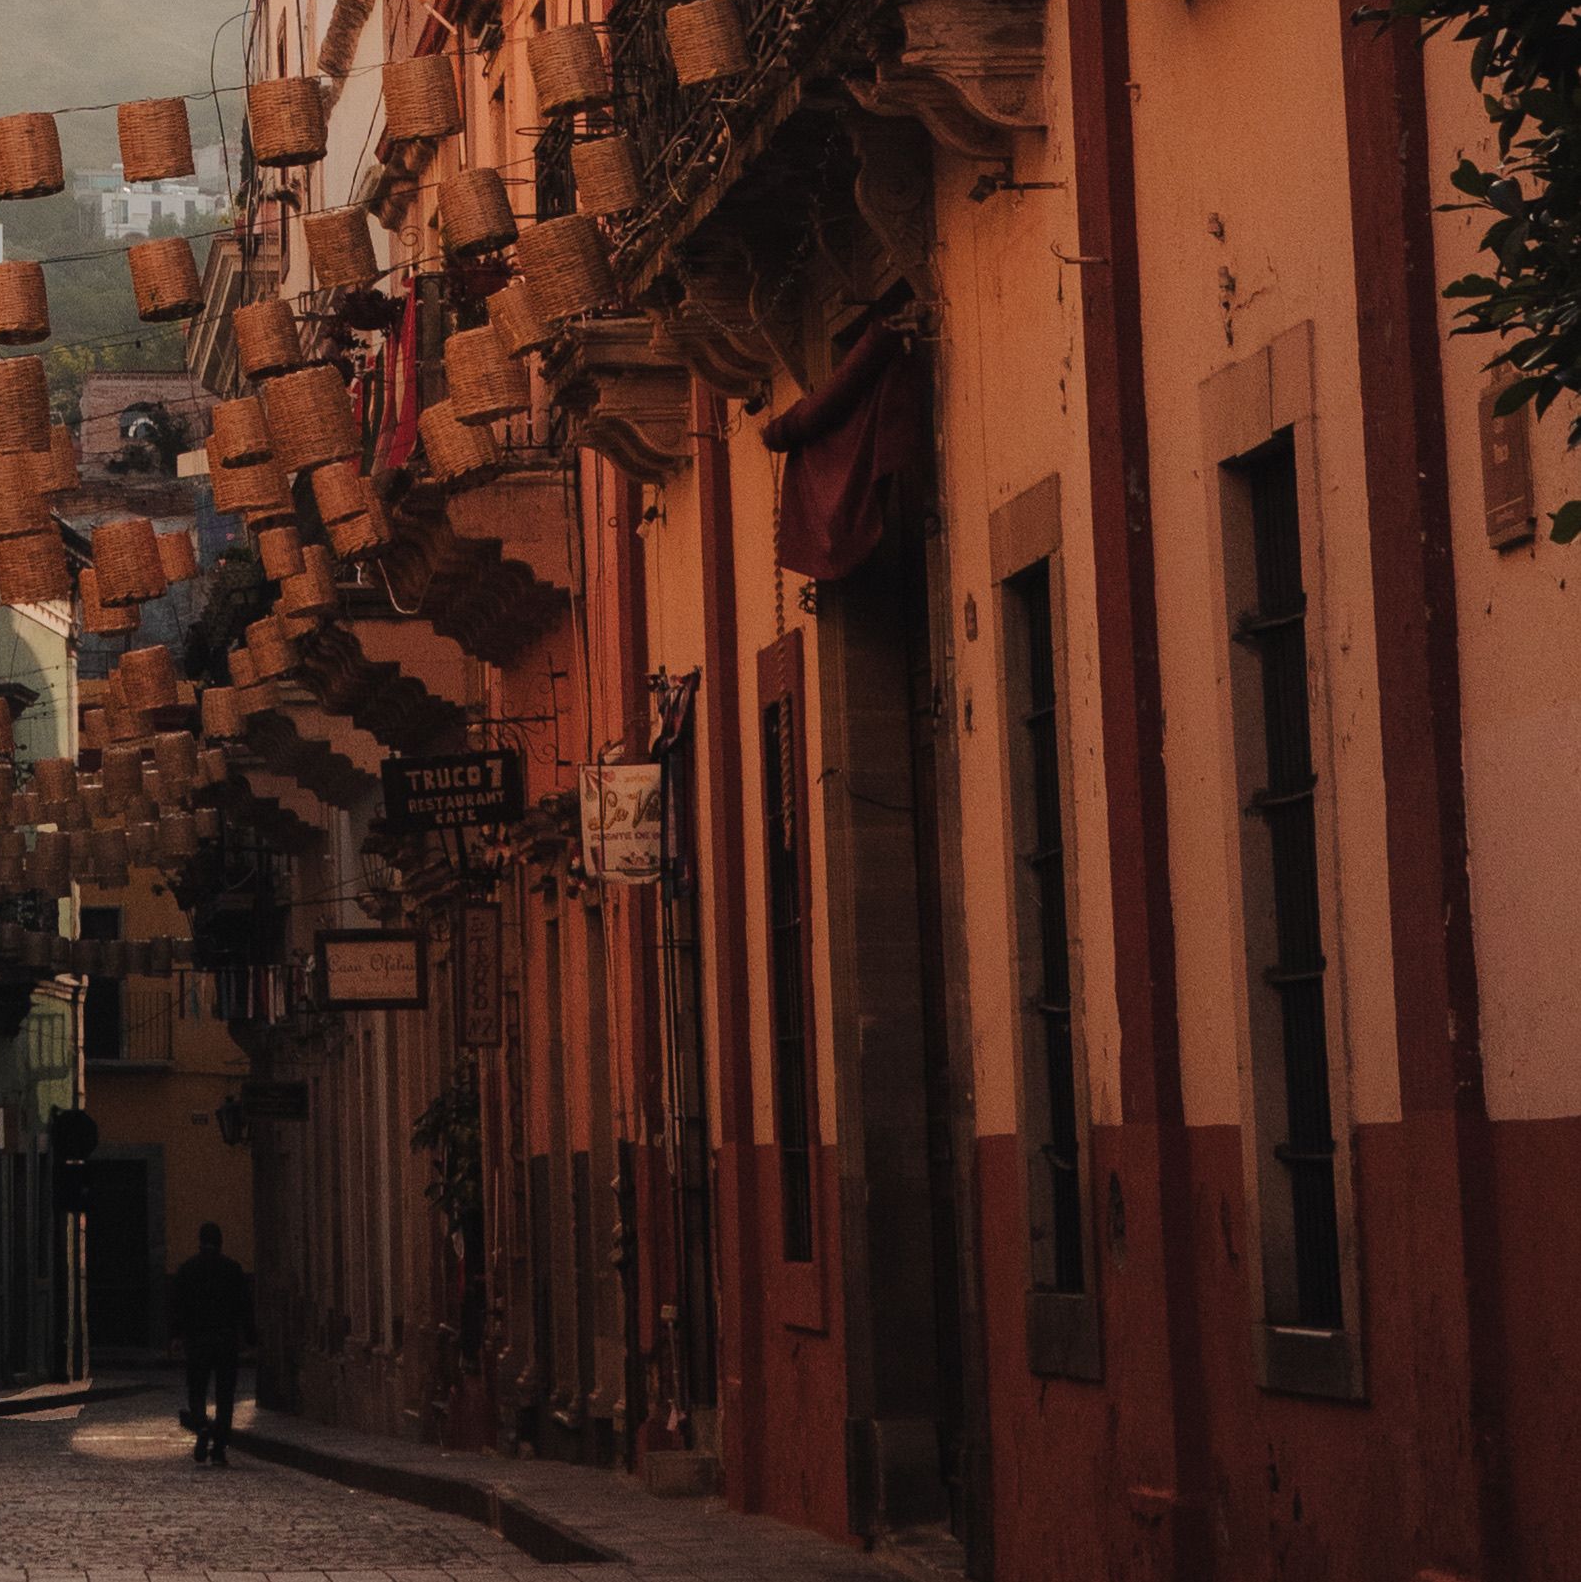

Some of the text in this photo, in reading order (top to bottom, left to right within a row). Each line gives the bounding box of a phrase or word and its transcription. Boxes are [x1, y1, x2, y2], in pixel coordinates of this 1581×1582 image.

[404, 758, 504, 792] TRUCO 7
[407, 790, 506, 814] RESTAURANT
